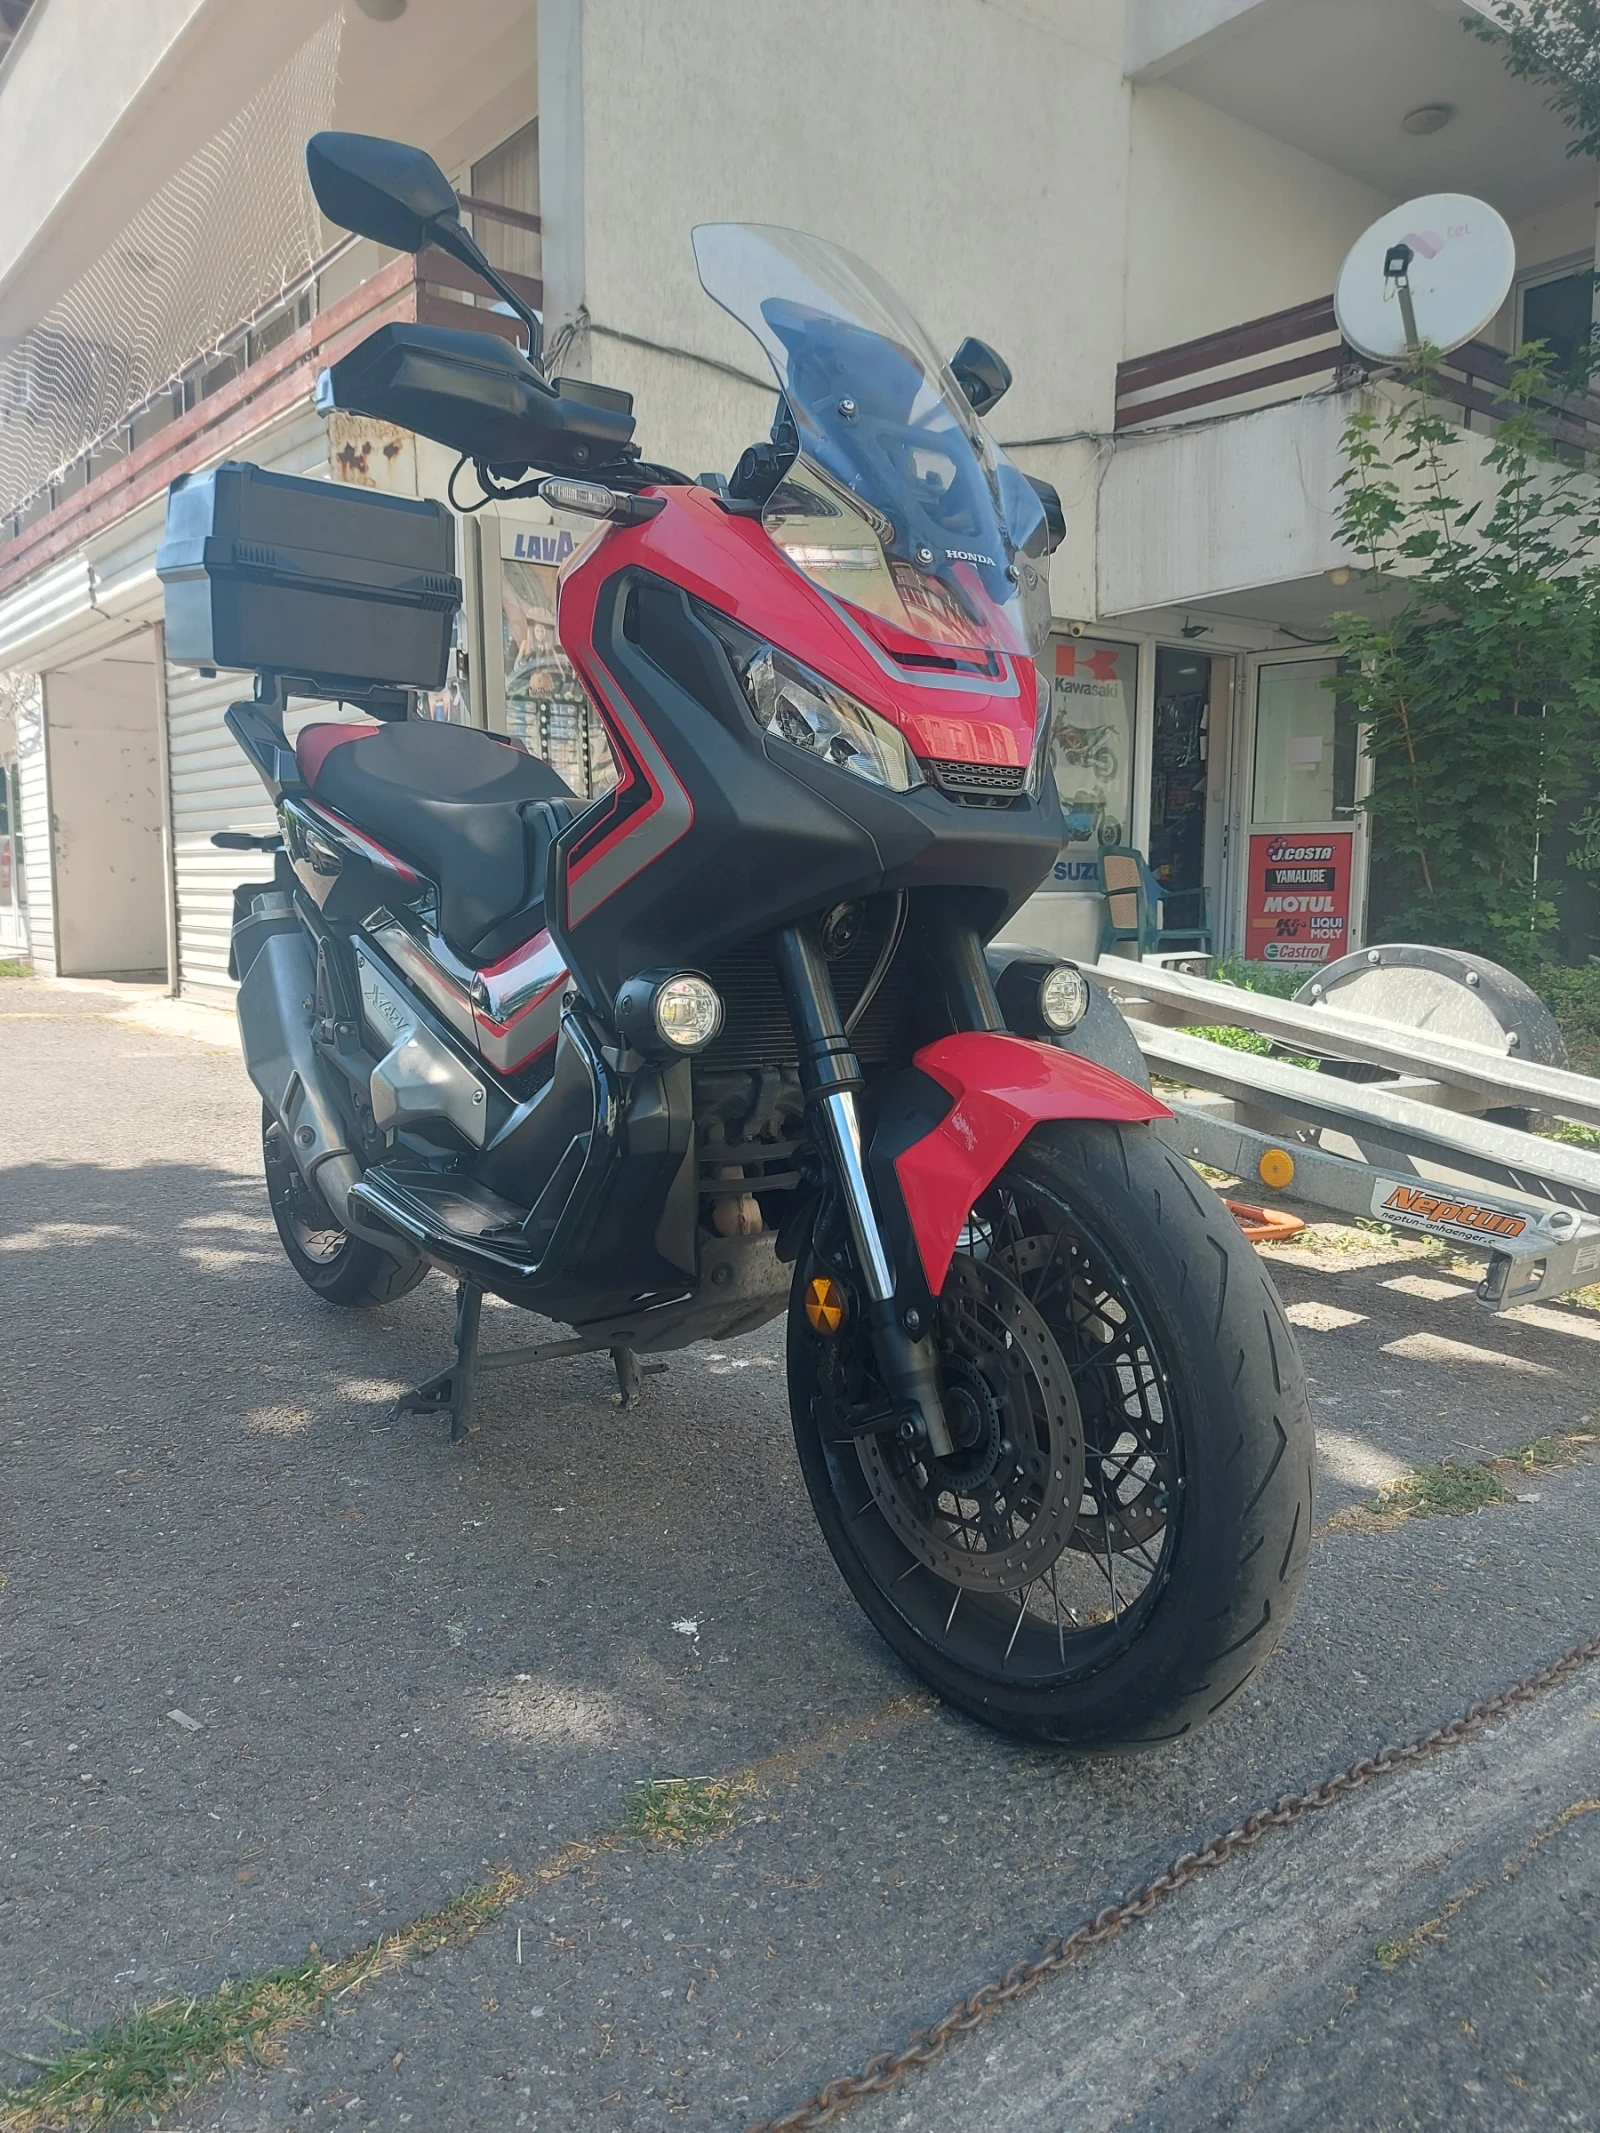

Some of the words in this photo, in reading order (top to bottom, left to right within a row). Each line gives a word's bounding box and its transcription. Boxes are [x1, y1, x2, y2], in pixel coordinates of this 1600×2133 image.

[514, 530, 580, 563] LAVA
[945, 549, 997, 567] HONDA
[1054, 677, 1118, 699] Kawasaki
[1271, 846, 1334, 861] J.COSTA
[1276, 869, 1325, 883] YAMALUBE
[1263, 896, 1335, 912] MOTUL
[1311, 917, 1343, 928] LIQUI
[1310, 928, 1343, 939] MOLY
[1279, 945, 1325, 959] Castrol
[1384, 1186, 1526, 1237] Neptun
